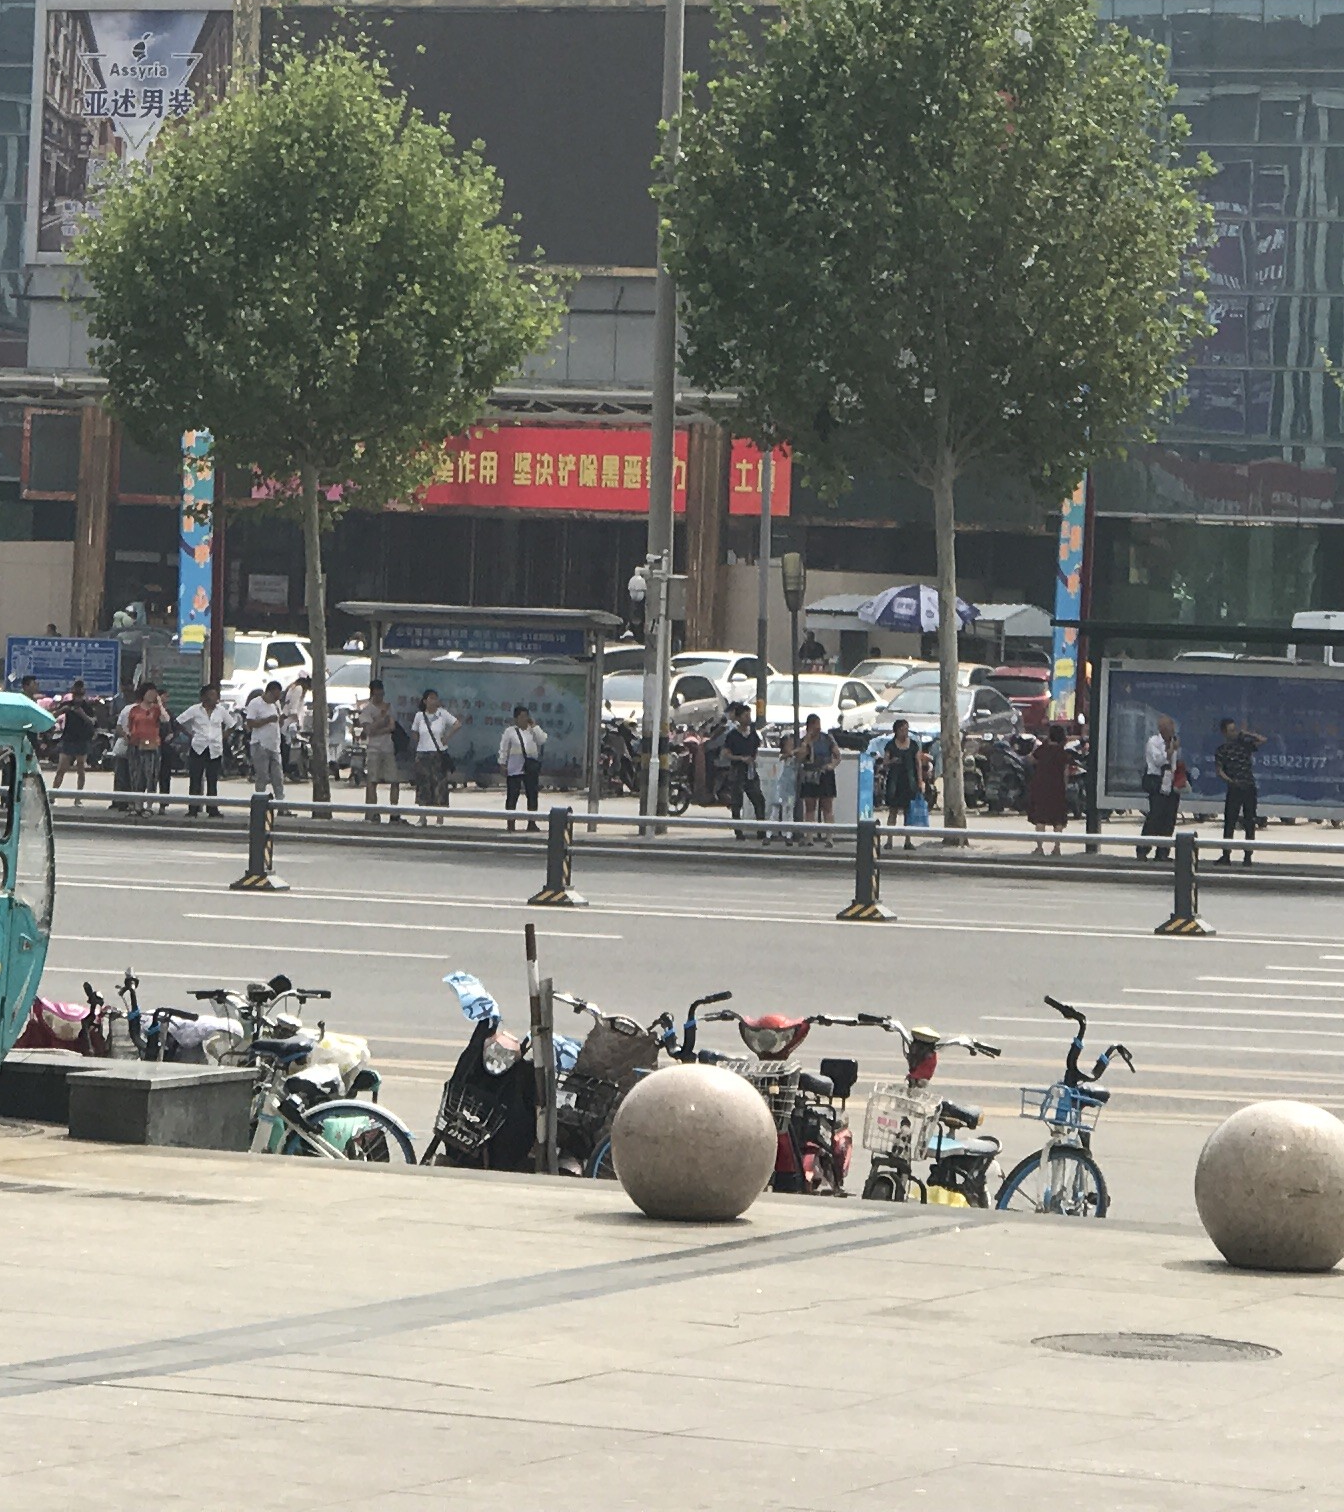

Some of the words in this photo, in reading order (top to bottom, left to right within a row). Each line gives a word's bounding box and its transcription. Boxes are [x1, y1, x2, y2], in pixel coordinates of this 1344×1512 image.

[109, 62, 169, 81] Assyria
[83, 88, 194, 120] 亚述男装
